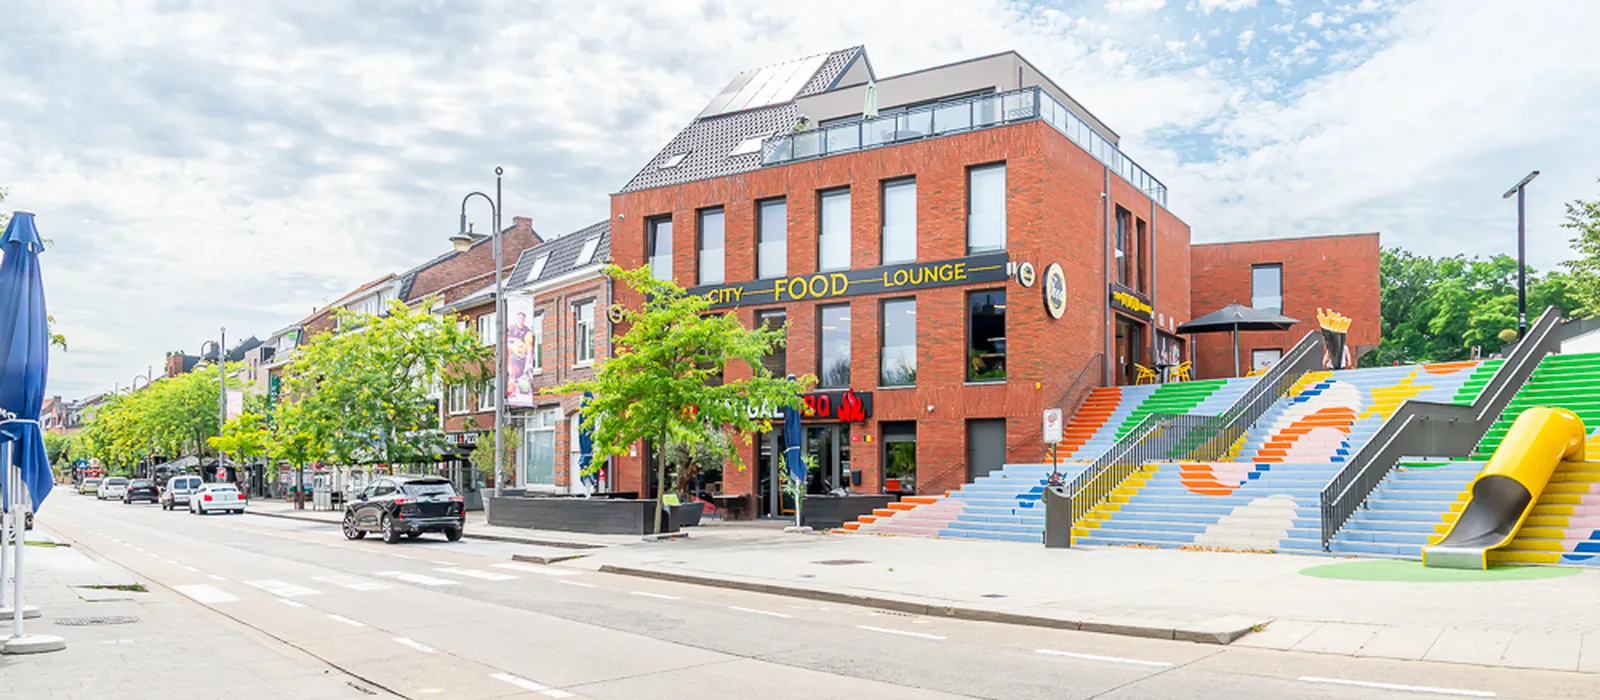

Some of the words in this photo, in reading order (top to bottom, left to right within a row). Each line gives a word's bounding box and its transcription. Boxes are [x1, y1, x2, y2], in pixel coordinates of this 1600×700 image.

[708, 287, 743, 304] CITY
[774, 273, 848, 301] FOOD
[883, 263, 967, 287] LOUNGE
